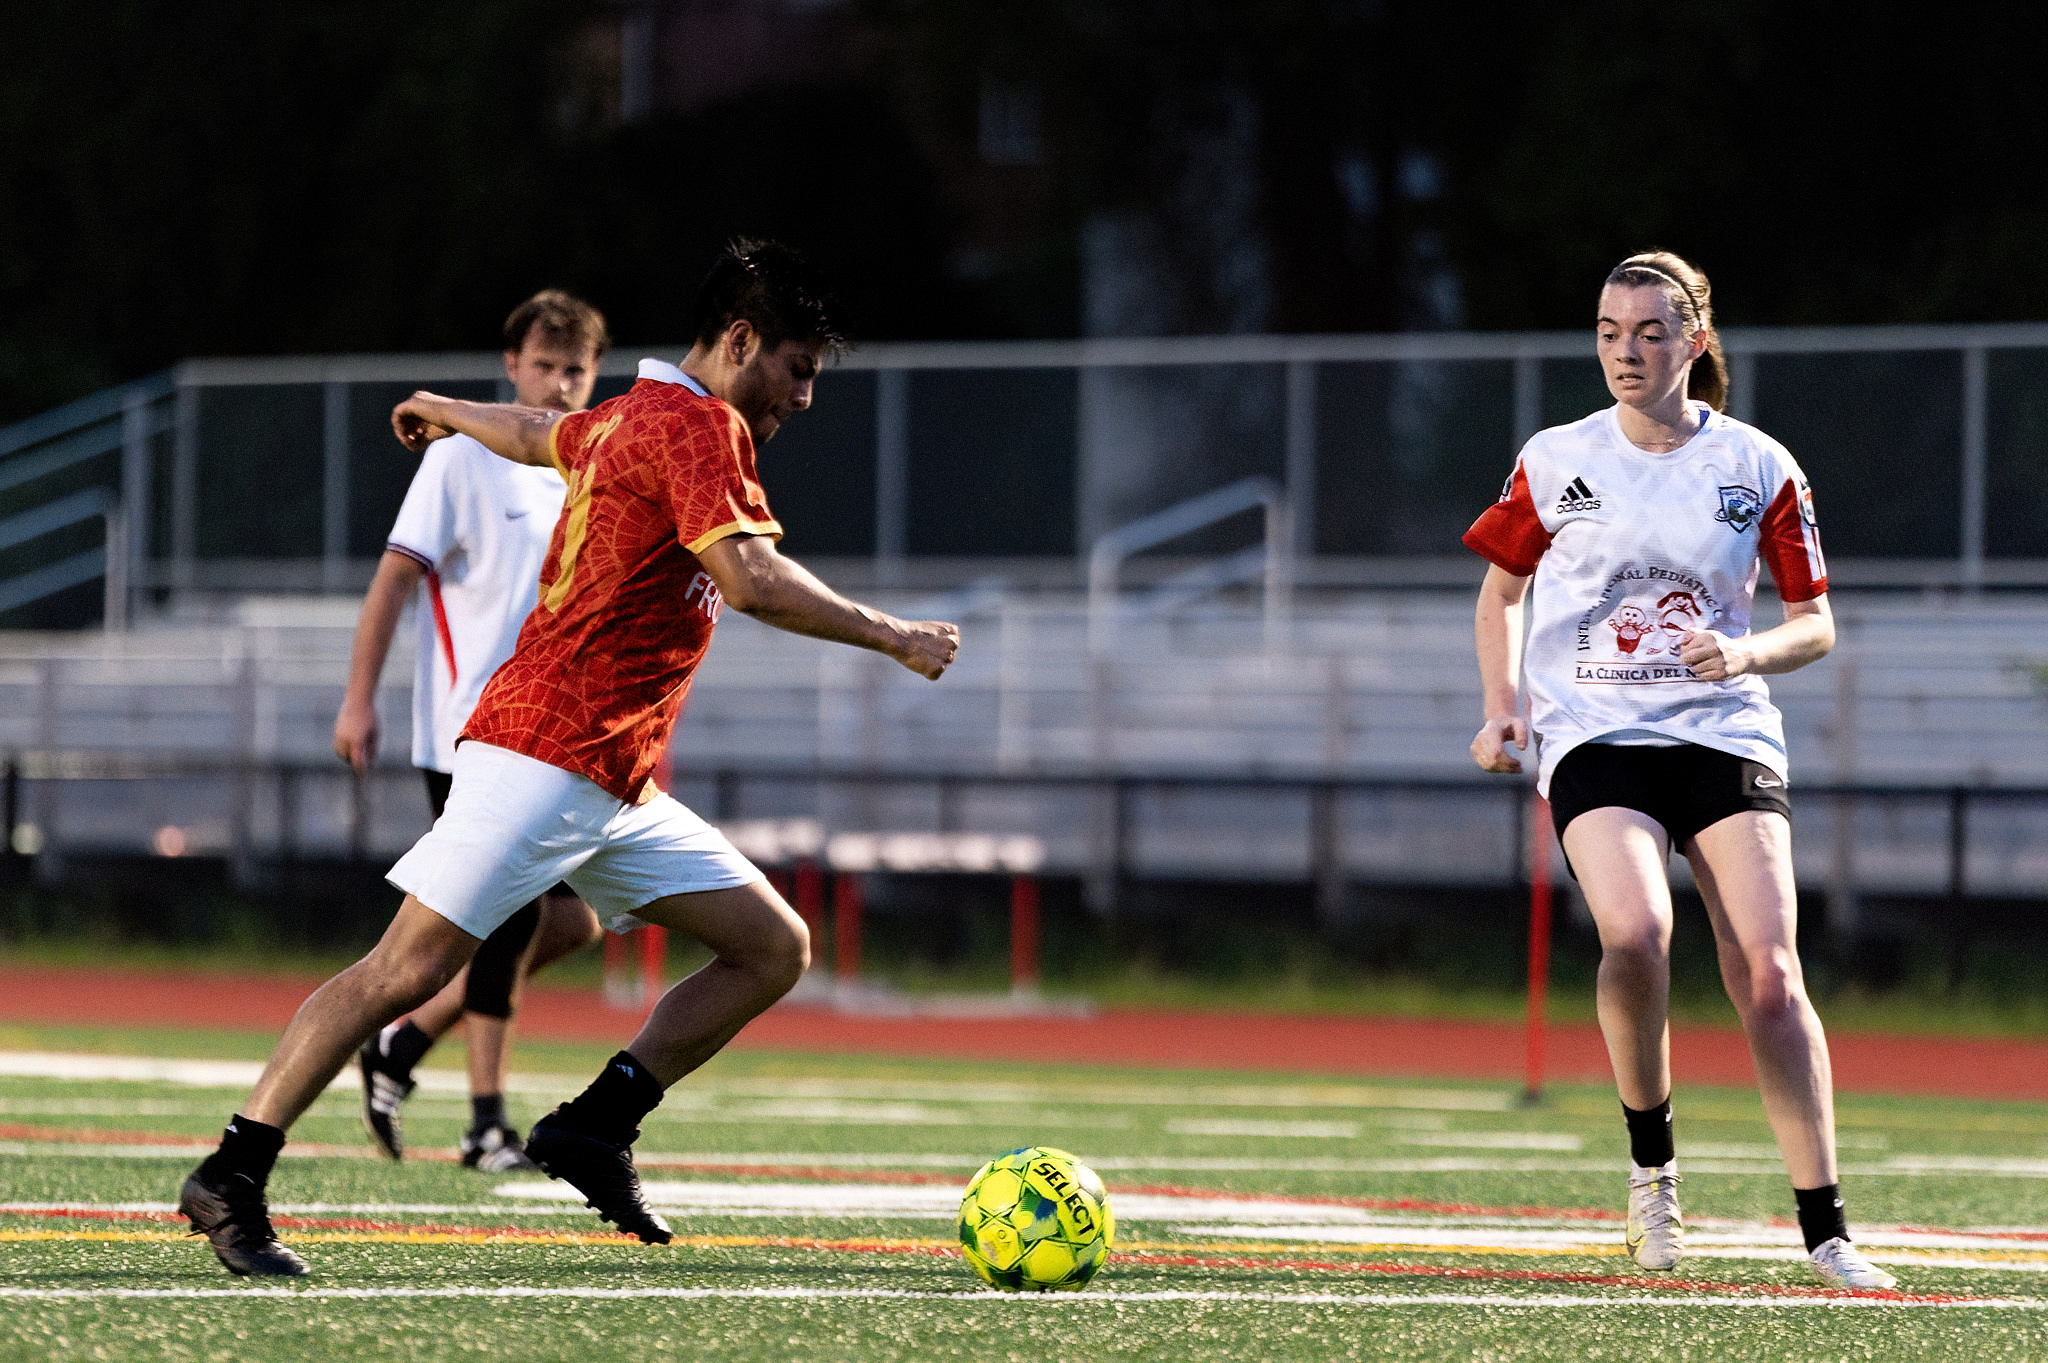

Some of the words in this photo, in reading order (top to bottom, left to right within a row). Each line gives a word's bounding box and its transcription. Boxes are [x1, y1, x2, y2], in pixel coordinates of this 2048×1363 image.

[1556, 499, 1601, 514] adidas
[1649, 566, 1718, 607] PEDIATRIC
[1596, 668, 1649, 681] CLINICA
[1653, 668, 1681, 679] DEL
[1033, 1162, 1095, 1236] SELECT
